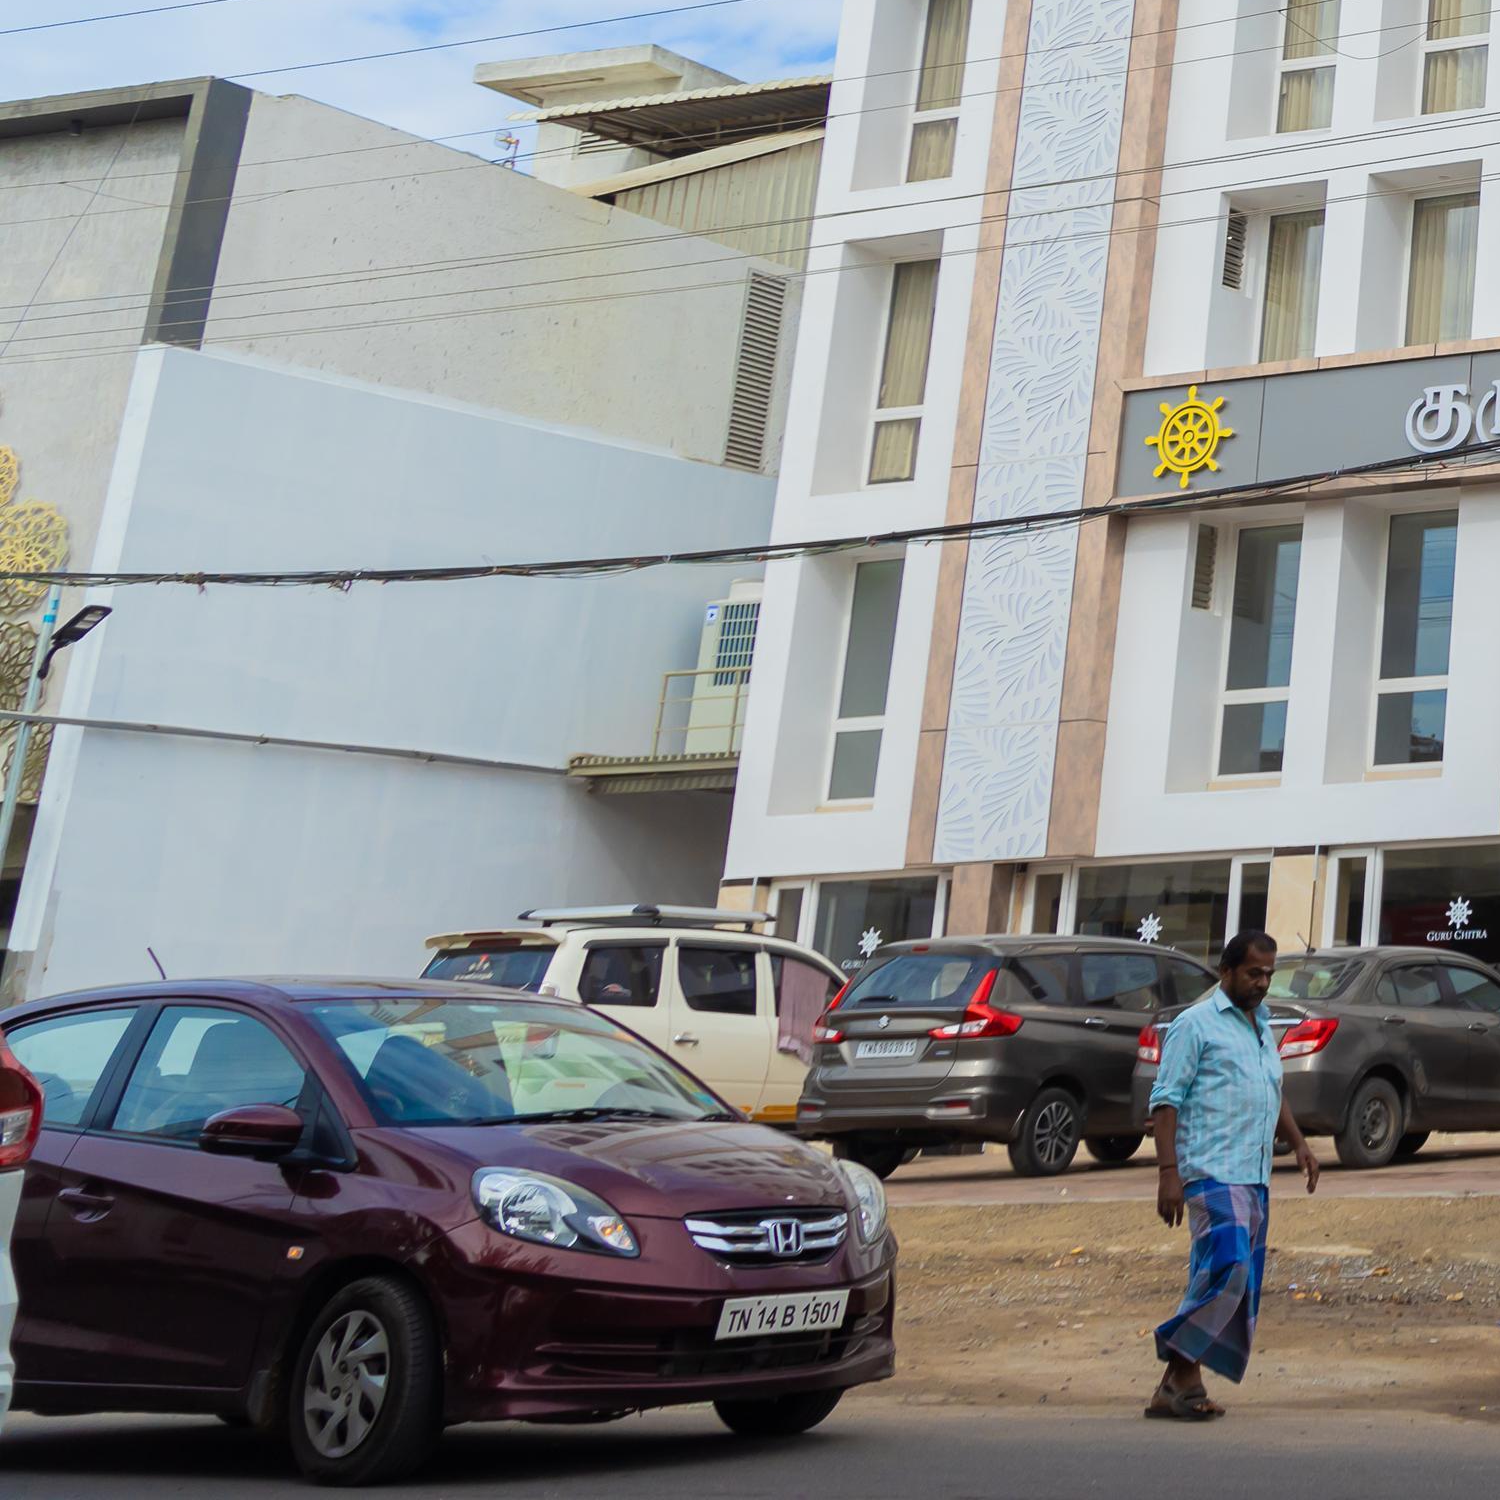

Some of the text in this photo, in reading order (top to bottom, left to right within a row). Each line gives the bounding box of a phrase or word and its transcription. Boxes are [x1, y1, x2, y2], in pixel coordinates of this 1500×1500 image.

[728, 1299, 841, 1333] TN 14 B 1501
